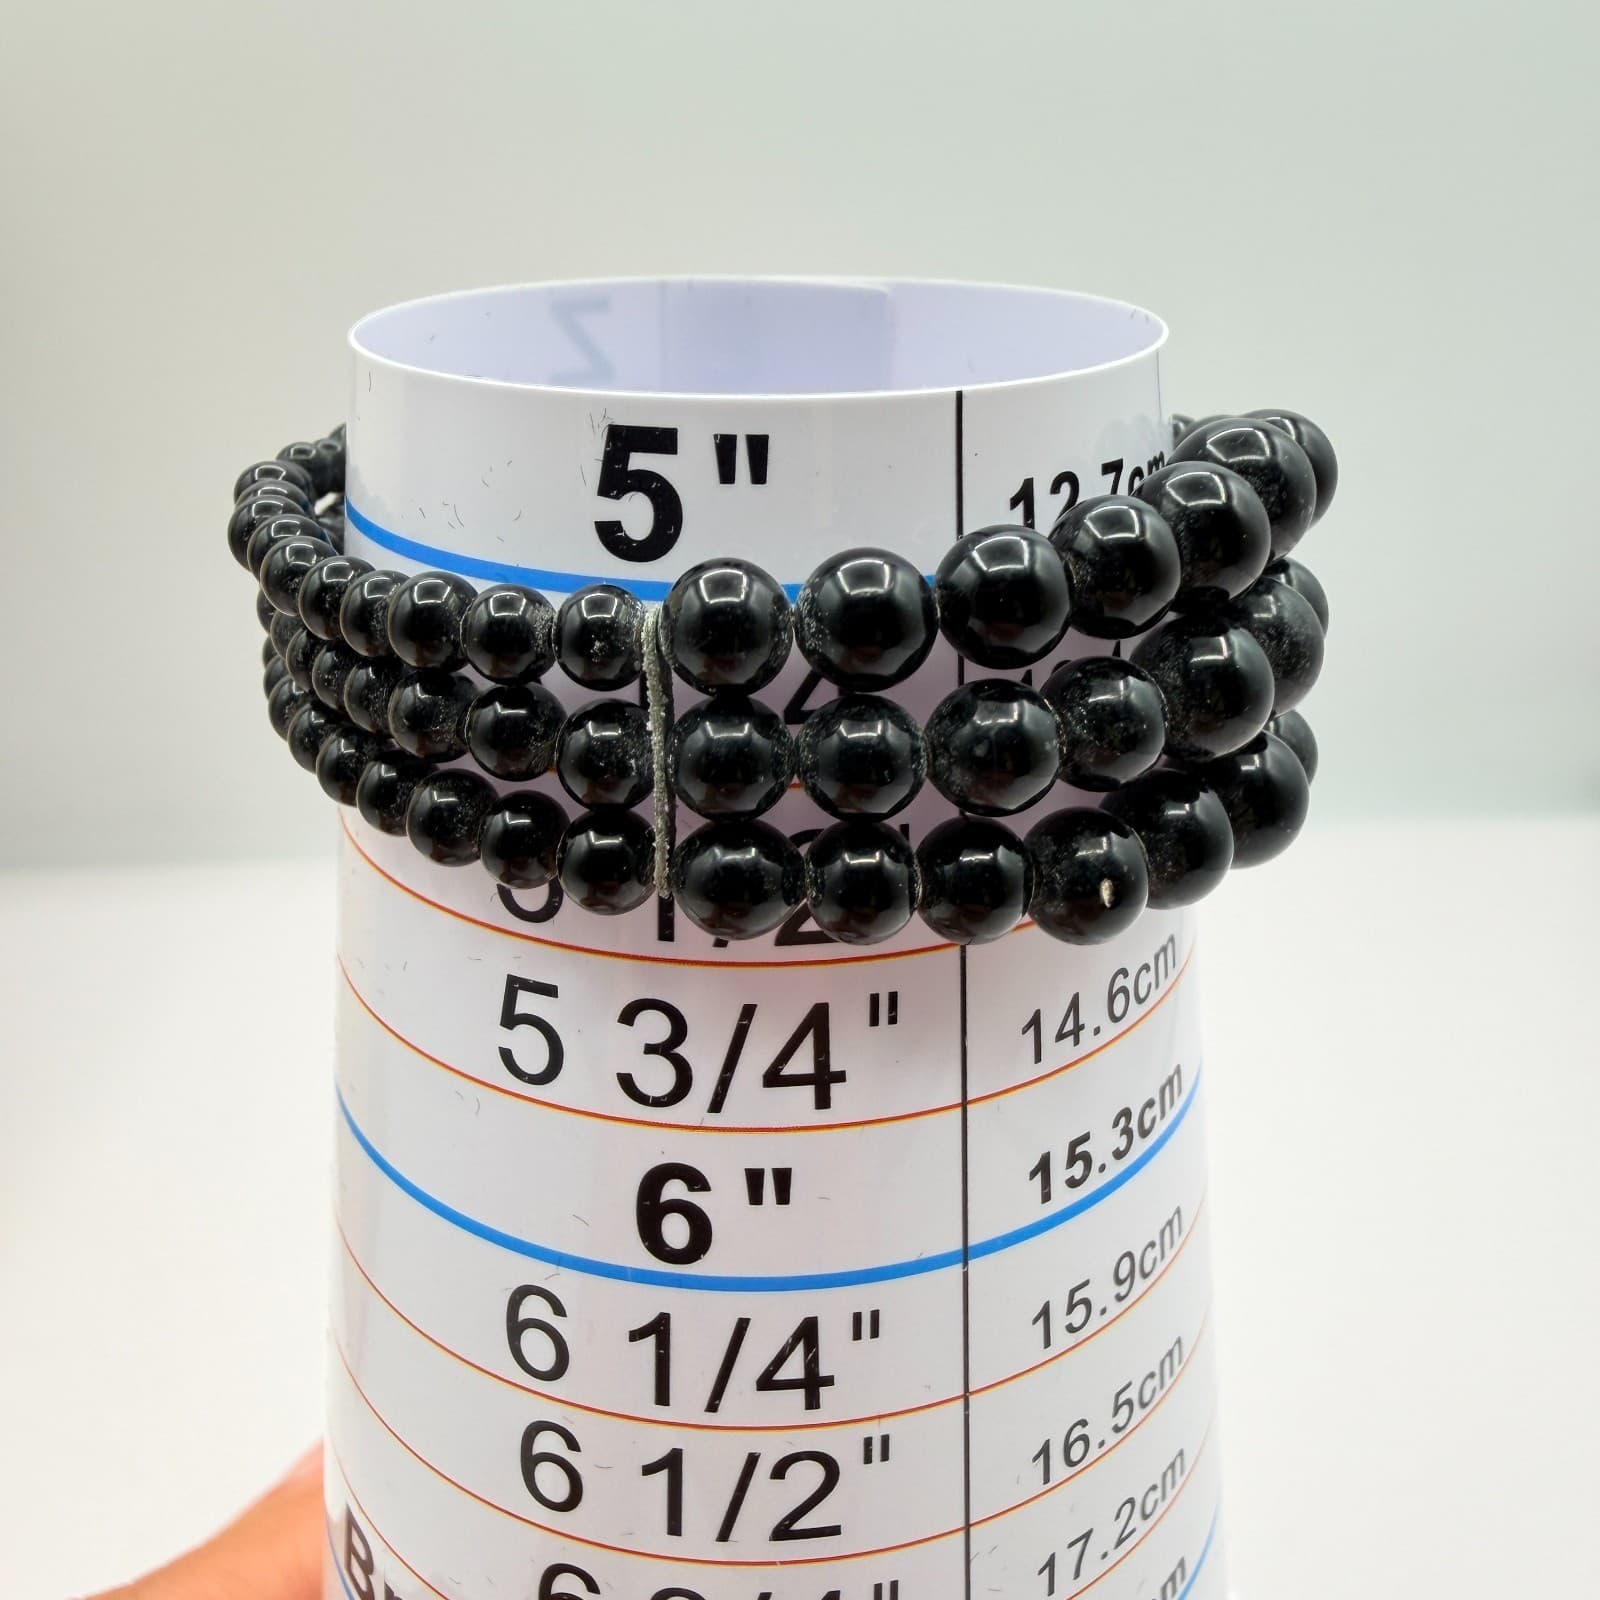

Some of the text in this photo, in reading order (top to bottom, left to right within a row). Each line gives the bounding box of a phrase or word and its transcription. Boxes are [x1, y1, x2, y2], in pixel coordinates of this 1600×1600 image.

[499, 974, 564, 1085] 5
[1021, 933, 1176, 1064] 14.6cm
[1029, 1063, 1182, 1204] 15.3cm
[507, 1285, 569, 1381] 6
[1032, 1206, 1183, 1349] 15.9cm
[521, 1421, 583, 1512] 6
[1032, 1336, 1183, 1485] 16.5cm
[1038, 1448, 1184, 1597] 17.2cm
